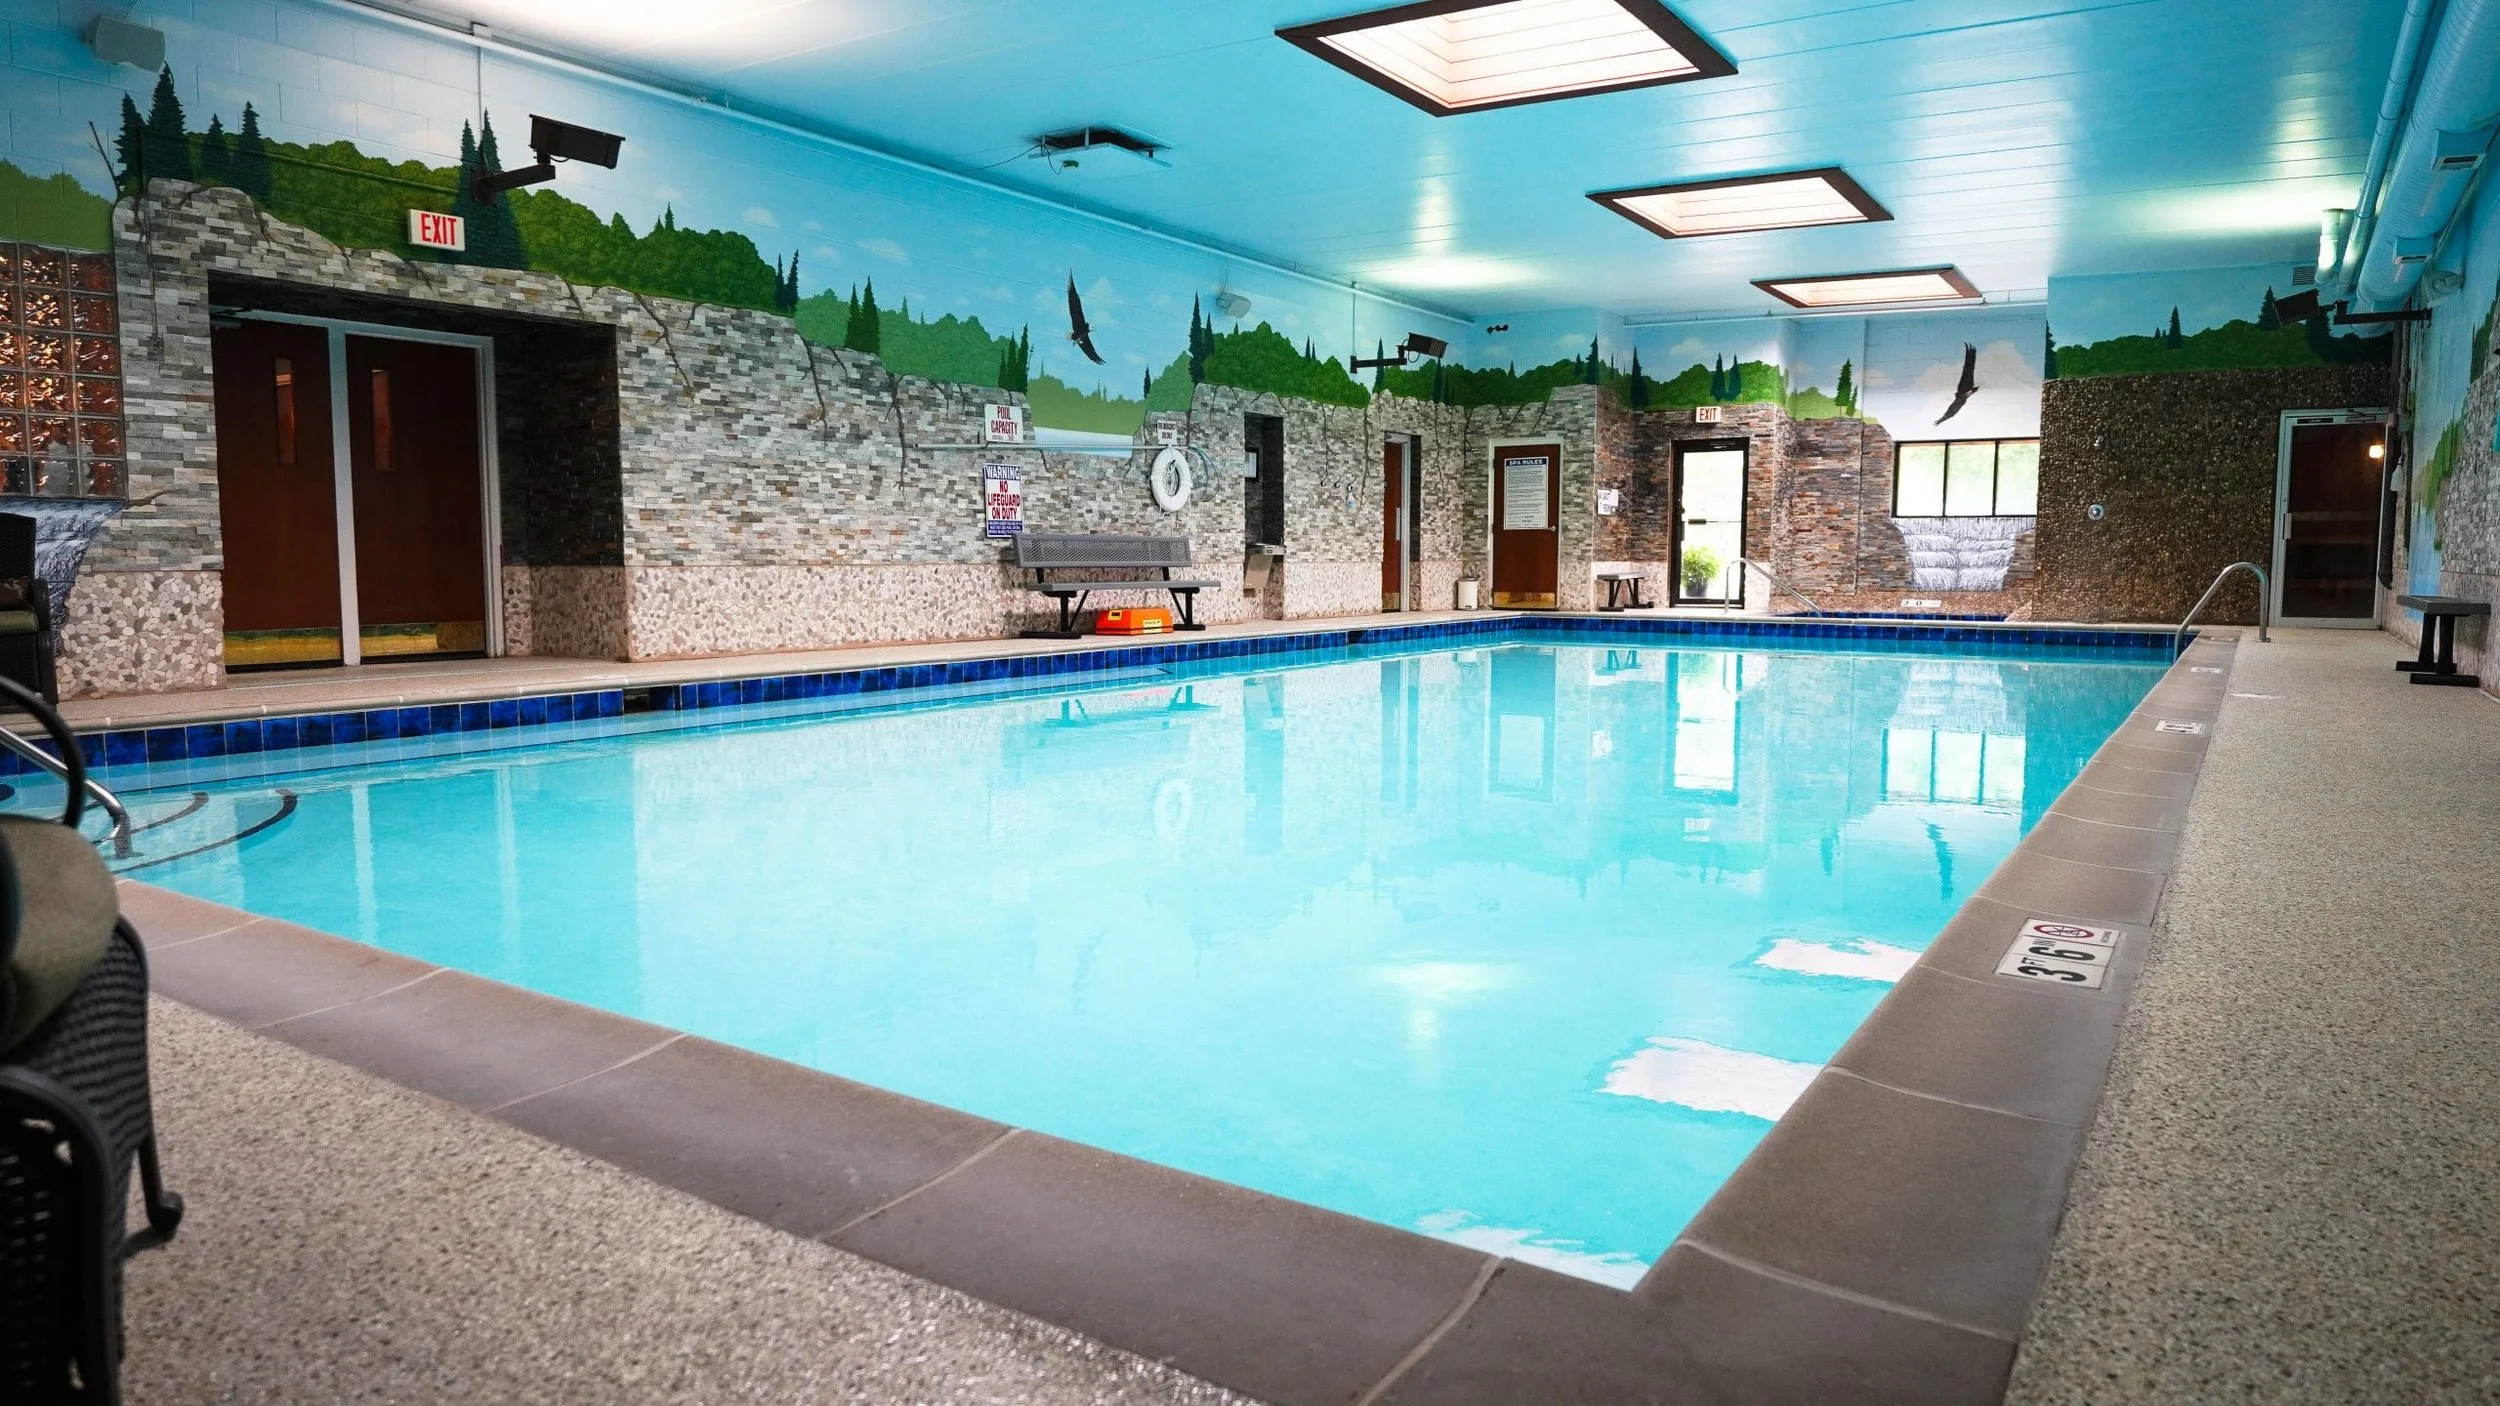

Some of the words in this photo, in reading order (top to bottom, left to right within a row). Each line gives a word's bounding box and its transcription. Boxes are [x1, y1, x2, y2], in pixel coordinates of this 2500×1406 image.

[421, 213, 457, 246] EXIT
[997, 405, 1011, 420] POOL
[1700, 407, 1717, 421] EXIT
[991, 420, 1018, 435] CAPACITY
[986, 465, 1021, 480] WARNING
[999, 480, 1008, 493] NO
[988, 493, 1021, 507] LIFEGUARD
[992, 507, 1000, 520] ON
[1002, 507, 1017, 520] DUTY
[2028, 946, 2096, 961] 6
[2017, 965, 2087, 982] 3
